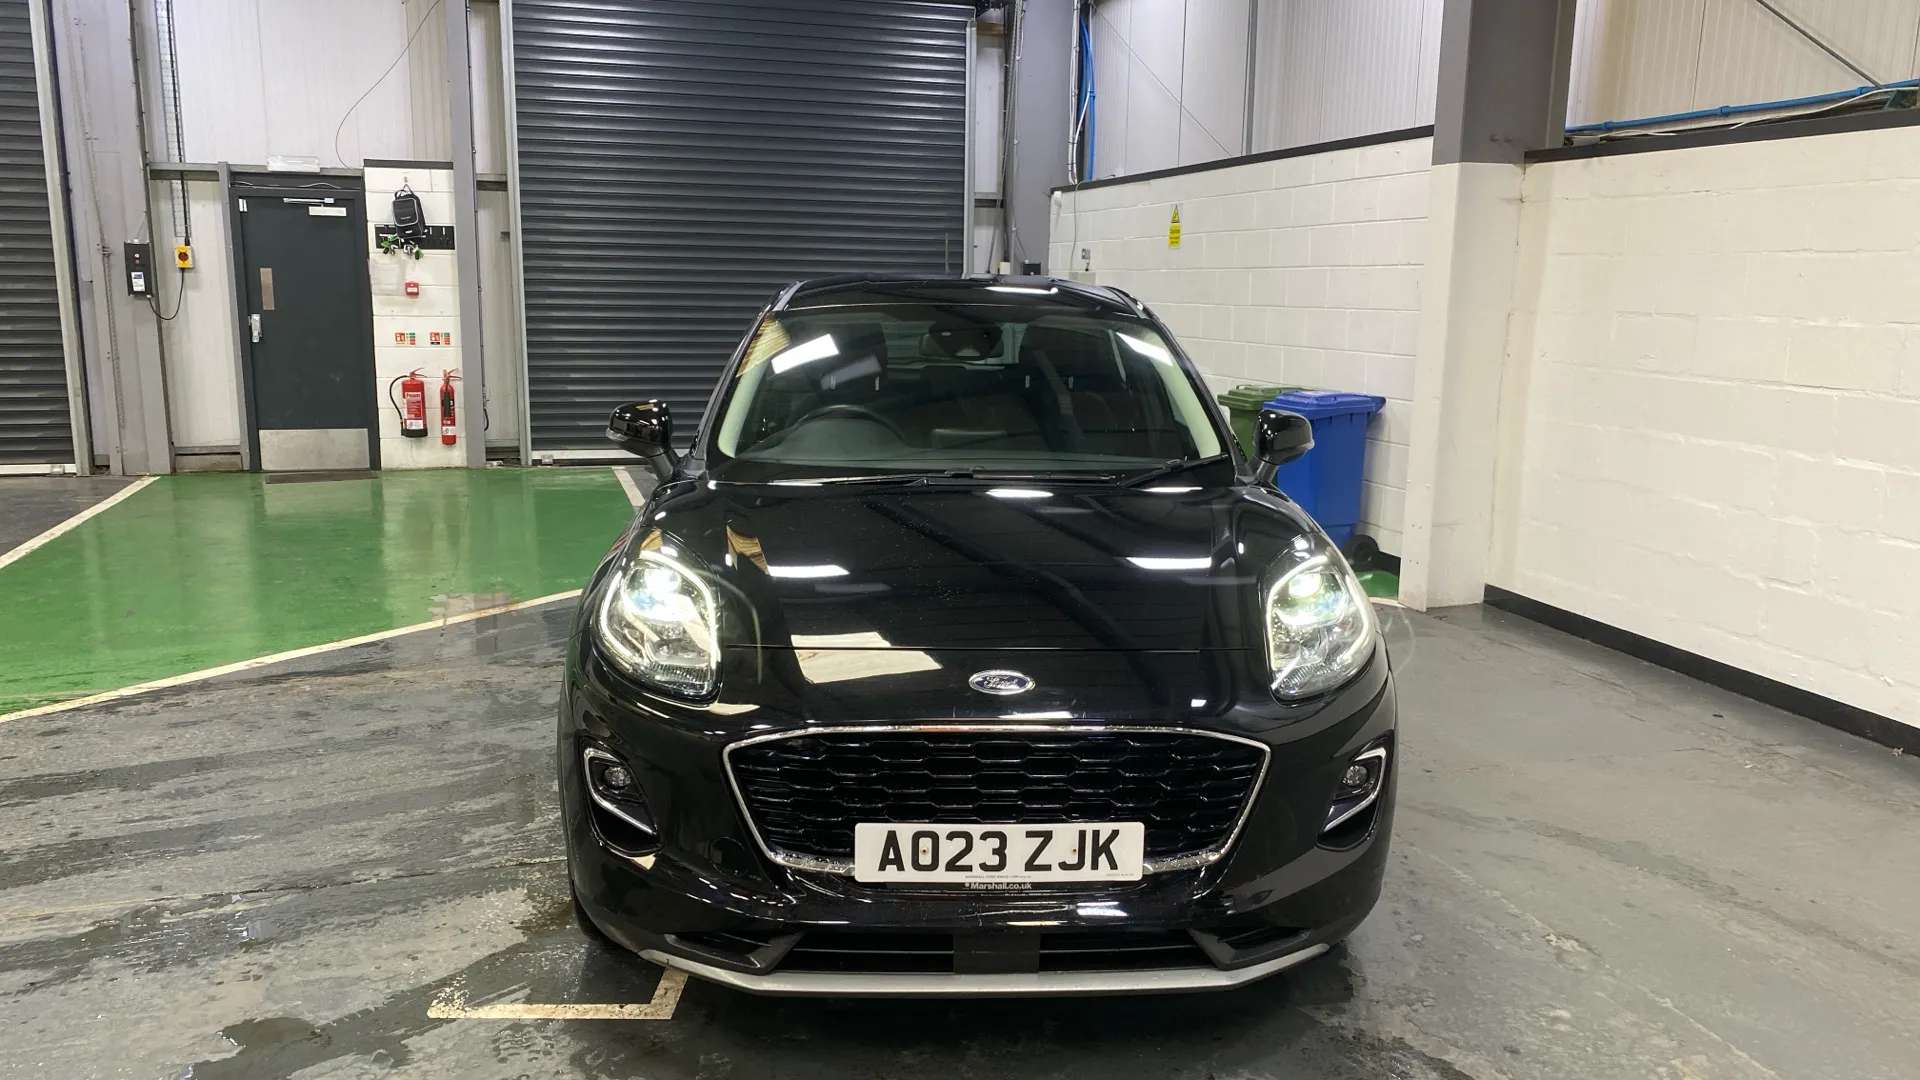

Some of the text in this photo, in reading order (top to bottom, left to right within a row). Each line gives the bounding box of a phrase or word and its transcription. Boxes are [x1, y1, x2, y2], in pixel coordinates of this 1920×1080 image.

[878, 829, 1120, 872] AO23 ZJK
[971, 882, 1032, 890] Marshall.co.uk
